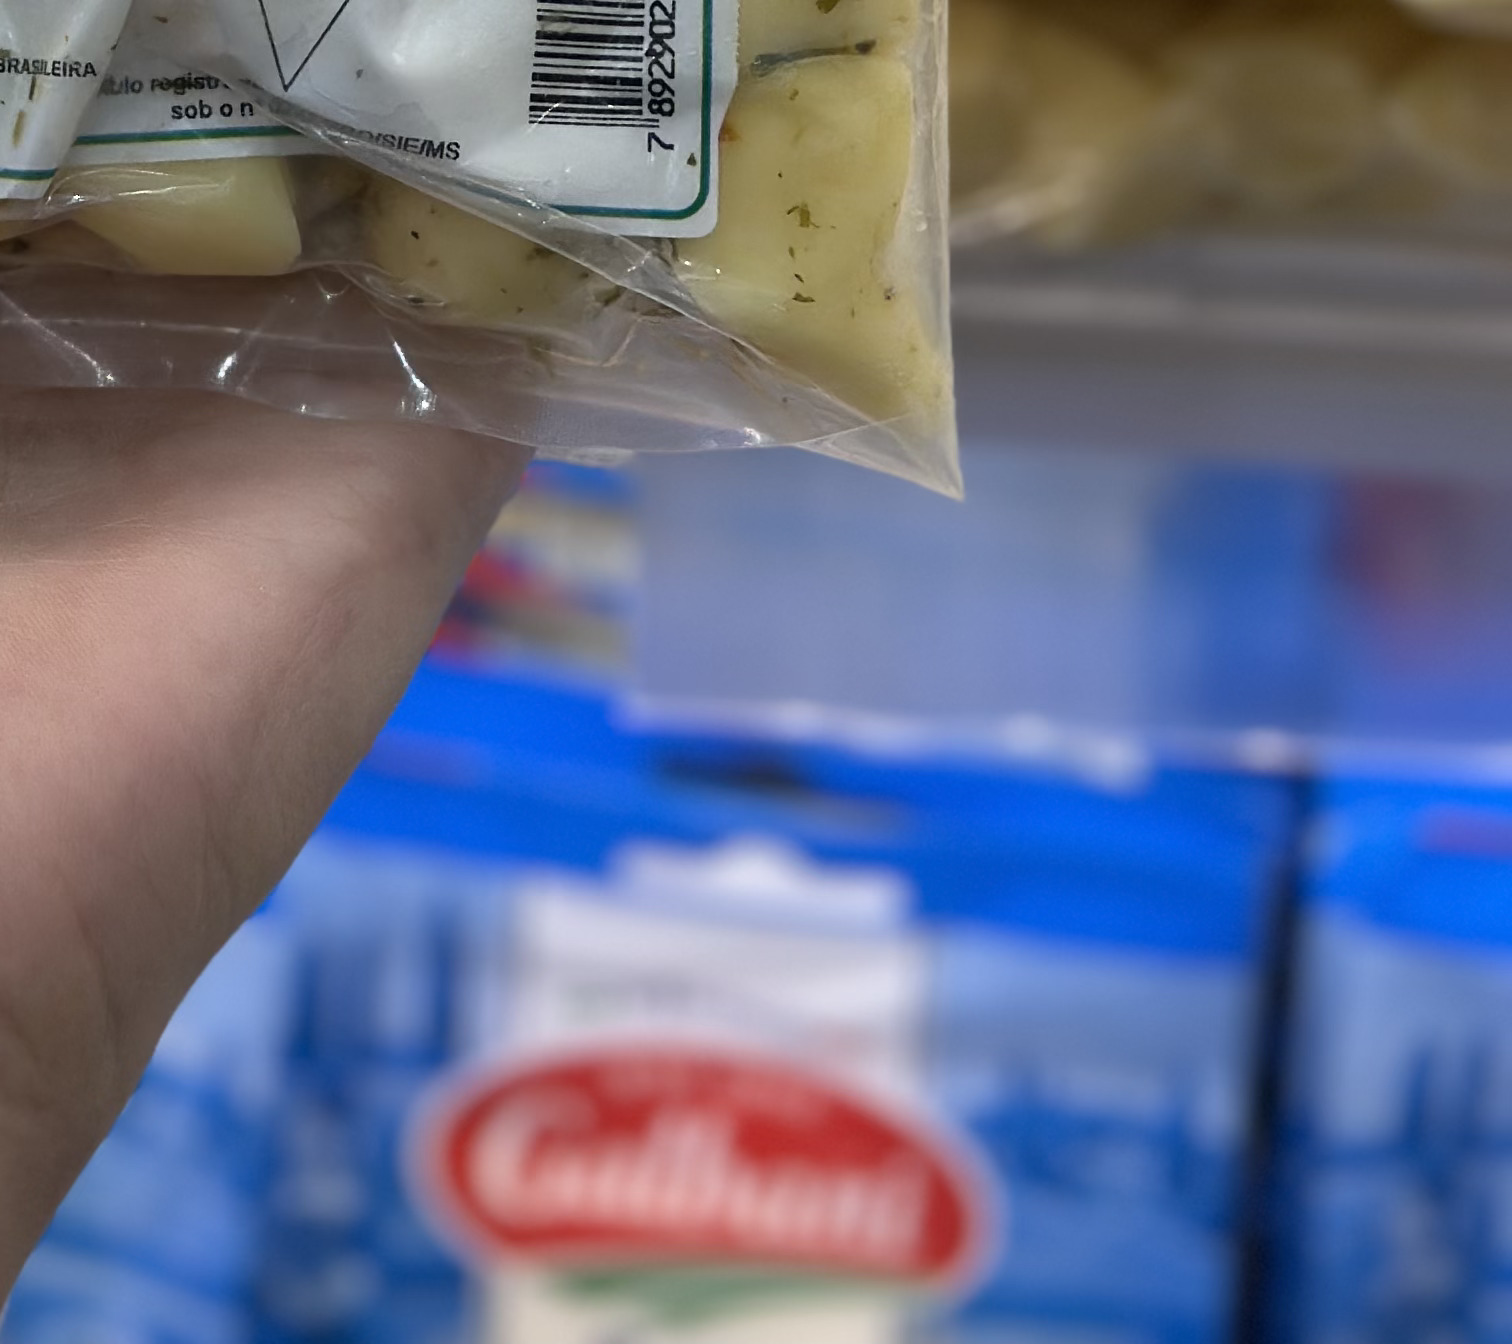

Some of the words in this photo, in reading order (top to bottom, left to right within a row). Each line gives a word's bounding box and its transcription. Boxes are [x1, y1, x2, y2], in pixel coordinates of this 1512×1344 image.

[647, 0, 677, 118] 892902
[171, 99, 213, 120] sob
[647, 131, 675, 153] 7
